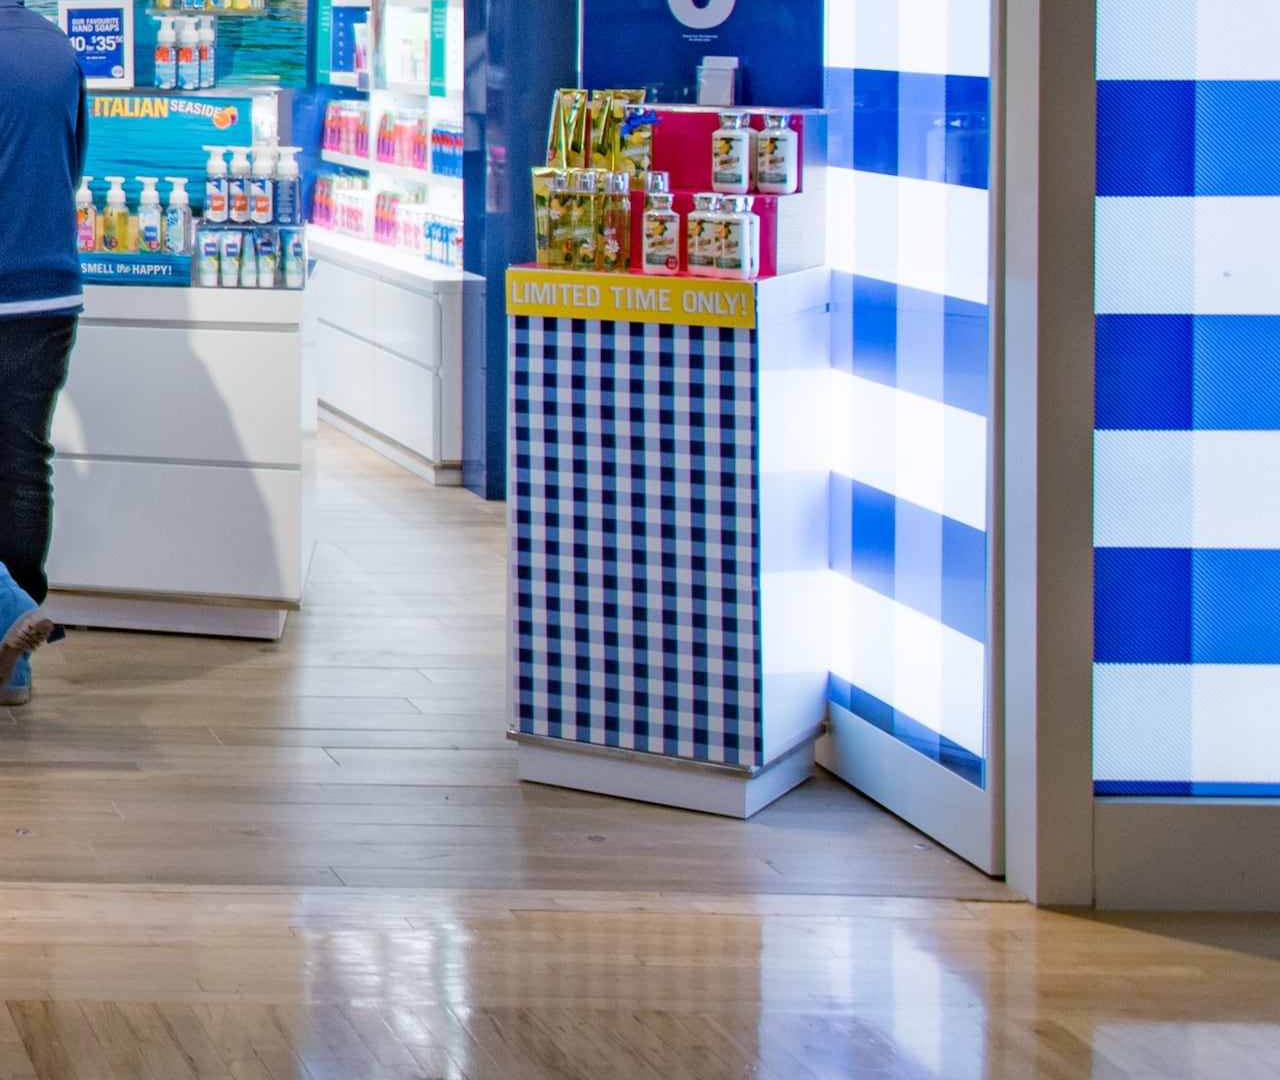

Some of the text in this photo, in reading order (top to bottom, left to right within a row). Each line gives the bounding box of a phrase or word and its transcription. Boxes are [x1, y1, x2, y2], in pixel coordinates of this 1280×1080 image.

[72, 23, 120, 32] HAND SOAPS
[93, 97, 222, 119] ITALIAN SEASIDE
[81, 262, 173, 276] SMELL the HAPPY!
[511, 281, 747, 316] LIMITED TIME ONLY!
